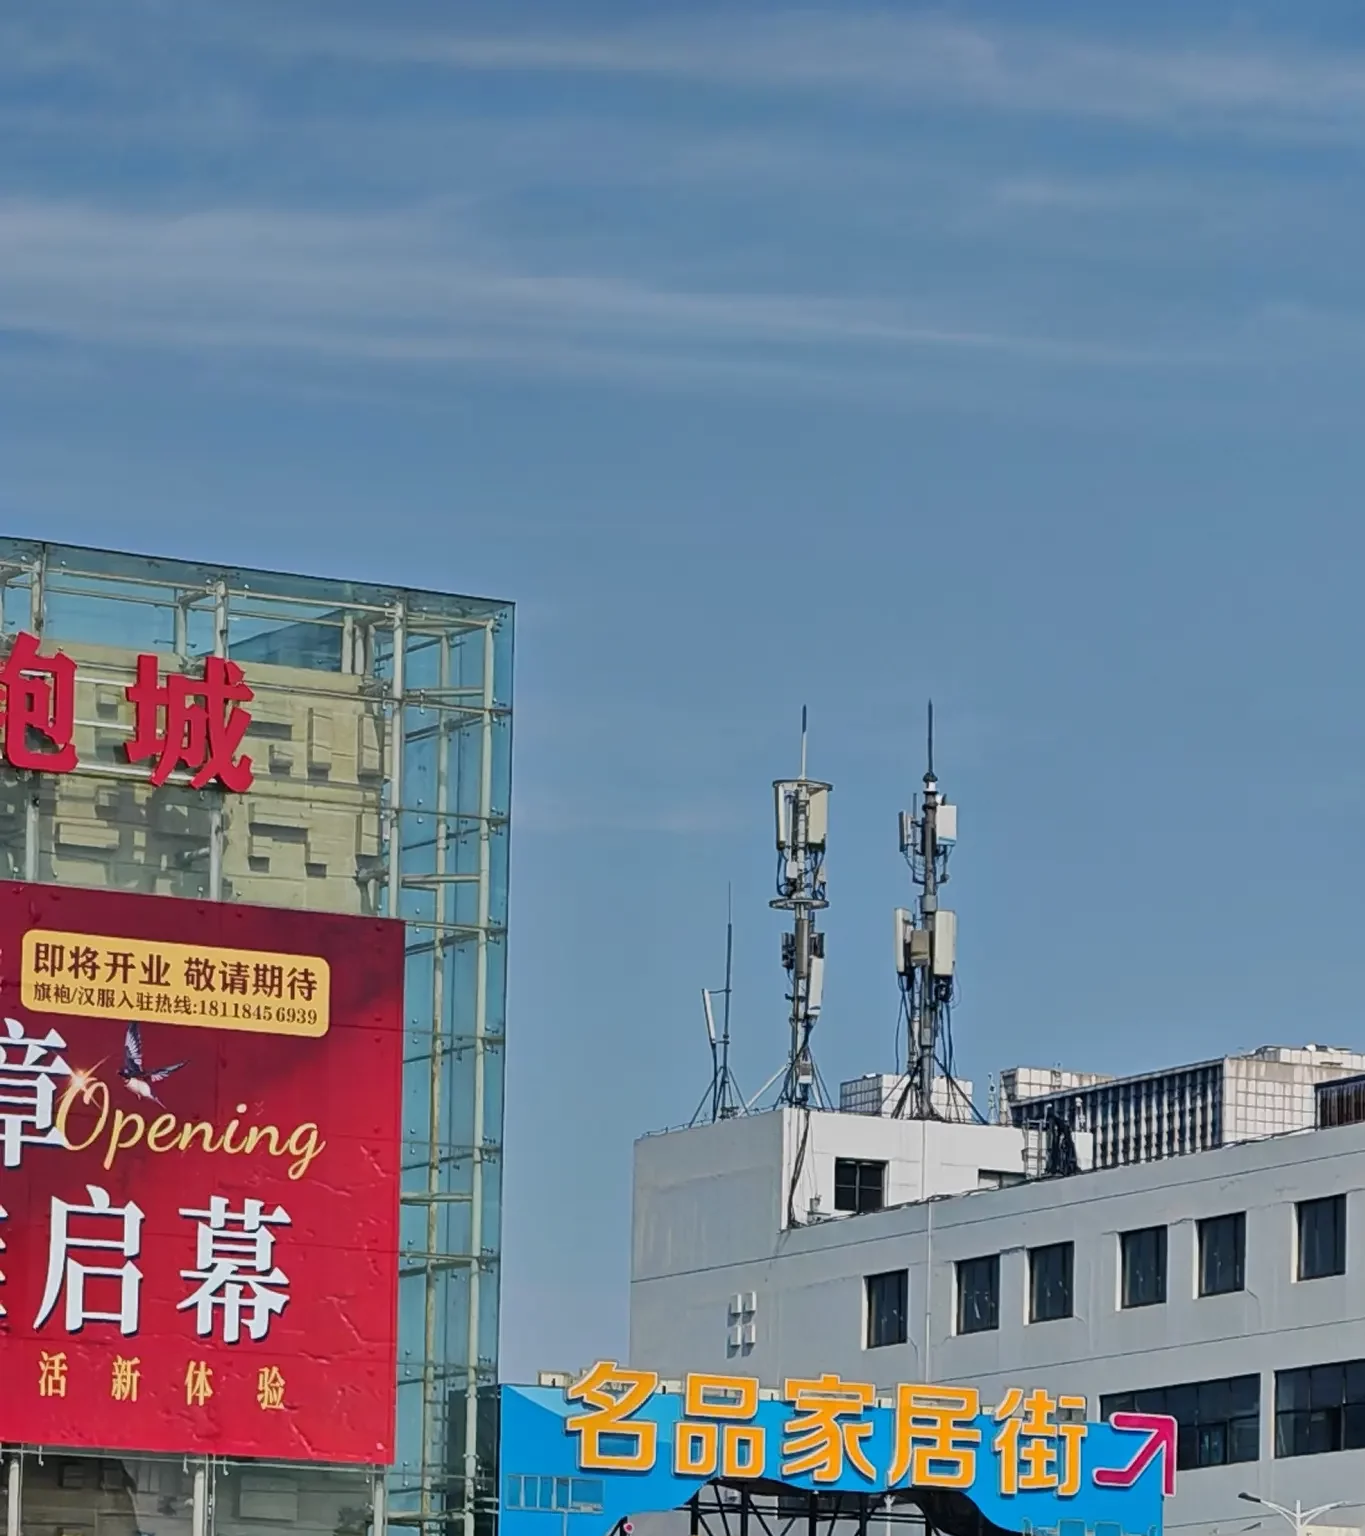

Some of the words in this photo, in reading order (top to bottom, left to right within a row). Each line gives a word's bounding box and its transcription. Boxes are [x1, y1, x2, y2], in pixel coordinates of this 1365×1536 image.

[34, 942, 172, 988] 即将开业
[184, 956, 318, 1002] 敬请期待
[56, 1077, 326, 1180] Opening
[0, 1185, 292, 1344] 启幕
[565, 1359, 1089, 1498] 名品家居街
